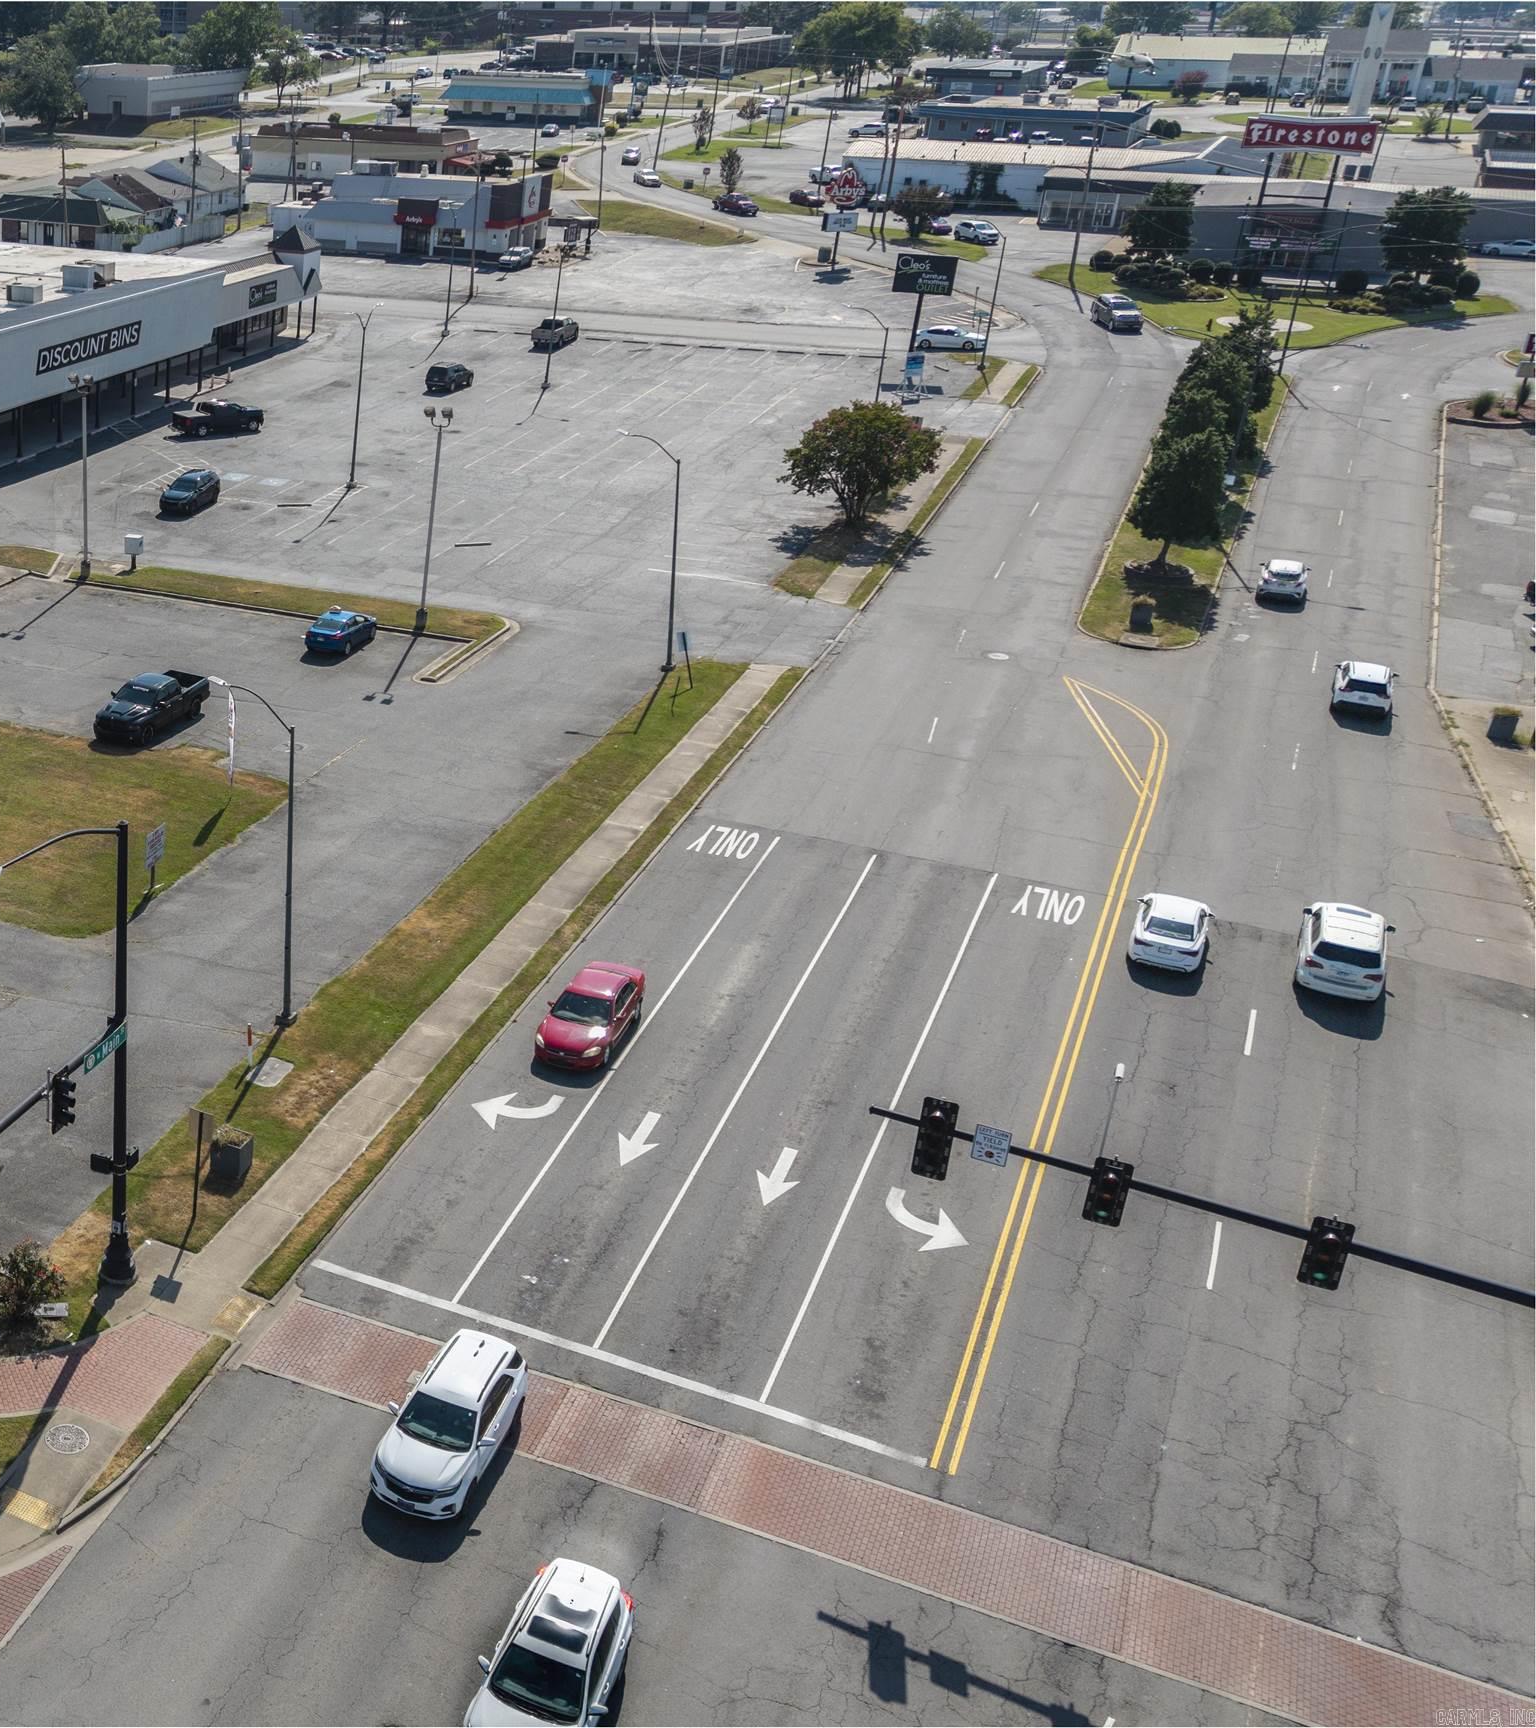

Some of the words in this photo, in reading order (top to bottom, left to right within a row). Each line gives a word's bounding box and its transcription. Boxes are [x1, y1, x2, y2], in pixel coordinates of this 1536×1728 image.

[1249, 122, 1373, 146] Firestone
[898, 256, 932, 270] Cleo's
[916, 284, 949, 293] OUTLET
[39, 334, 108, 371] DISCOUNT
[109, 324, 139, 350] BINS
[686, 824, 760, 860] ONLY
[1010, 884, 1086, 925] ONLY
[102, 1034, 120, 1058] Main
[983, 1135, 1003, 1146] YIELD
